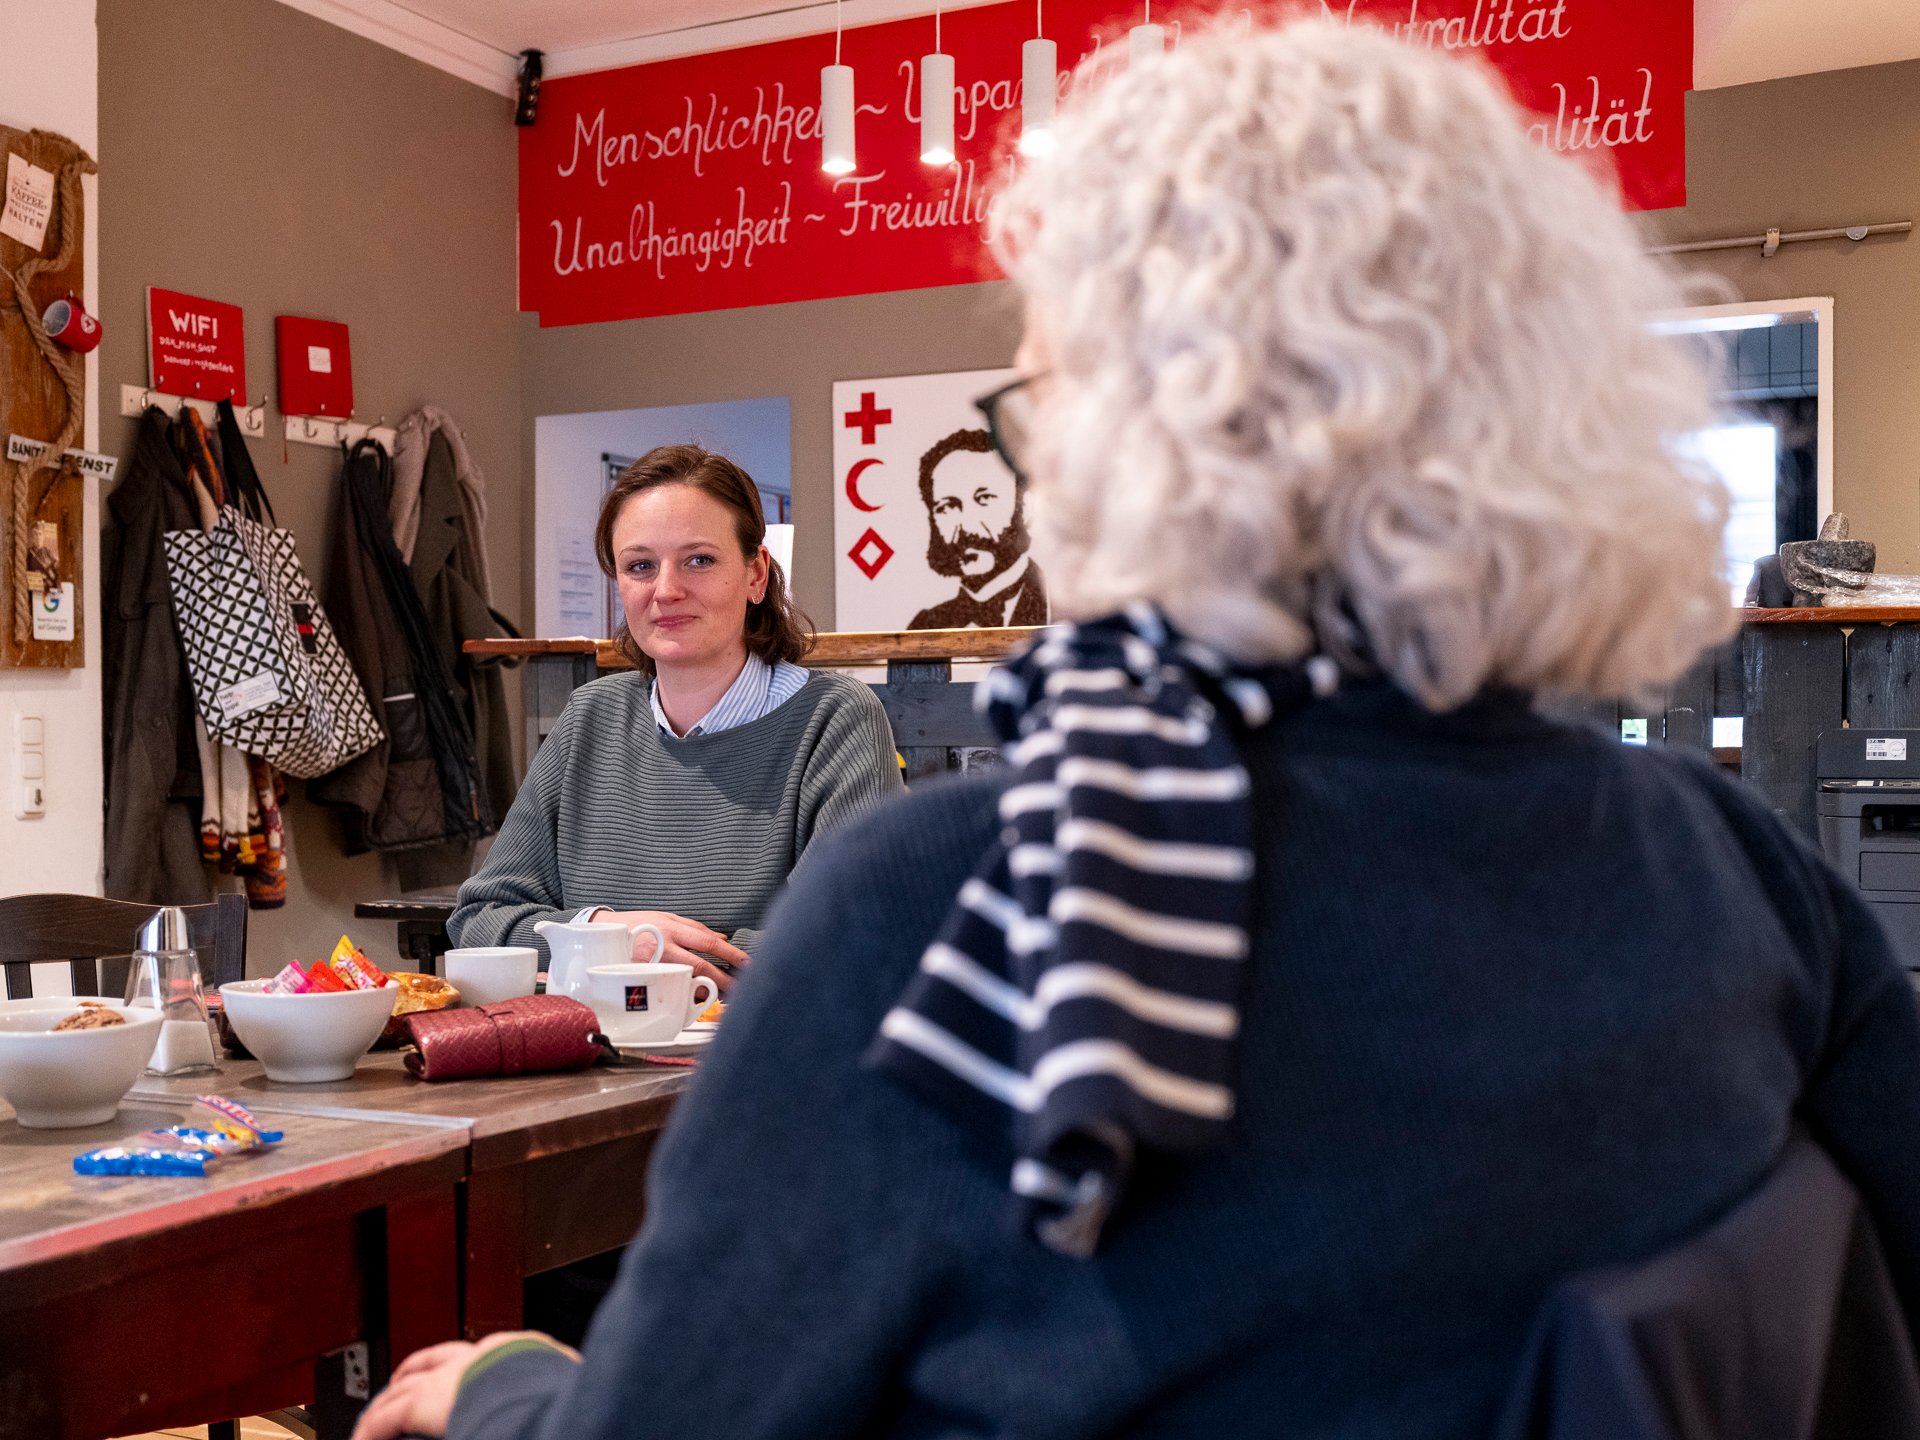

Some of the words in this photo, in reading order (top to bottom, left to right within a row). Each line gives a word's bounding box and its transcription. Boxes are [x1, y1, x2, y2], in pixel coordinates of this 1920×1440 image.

[550, 181, 791, 280] Unabhängigkeit
[1526, 67, 1655, 152] alität
[557, 81, 823, 187] Menschlichkei
[168, 309, 218, 339] WIFI
